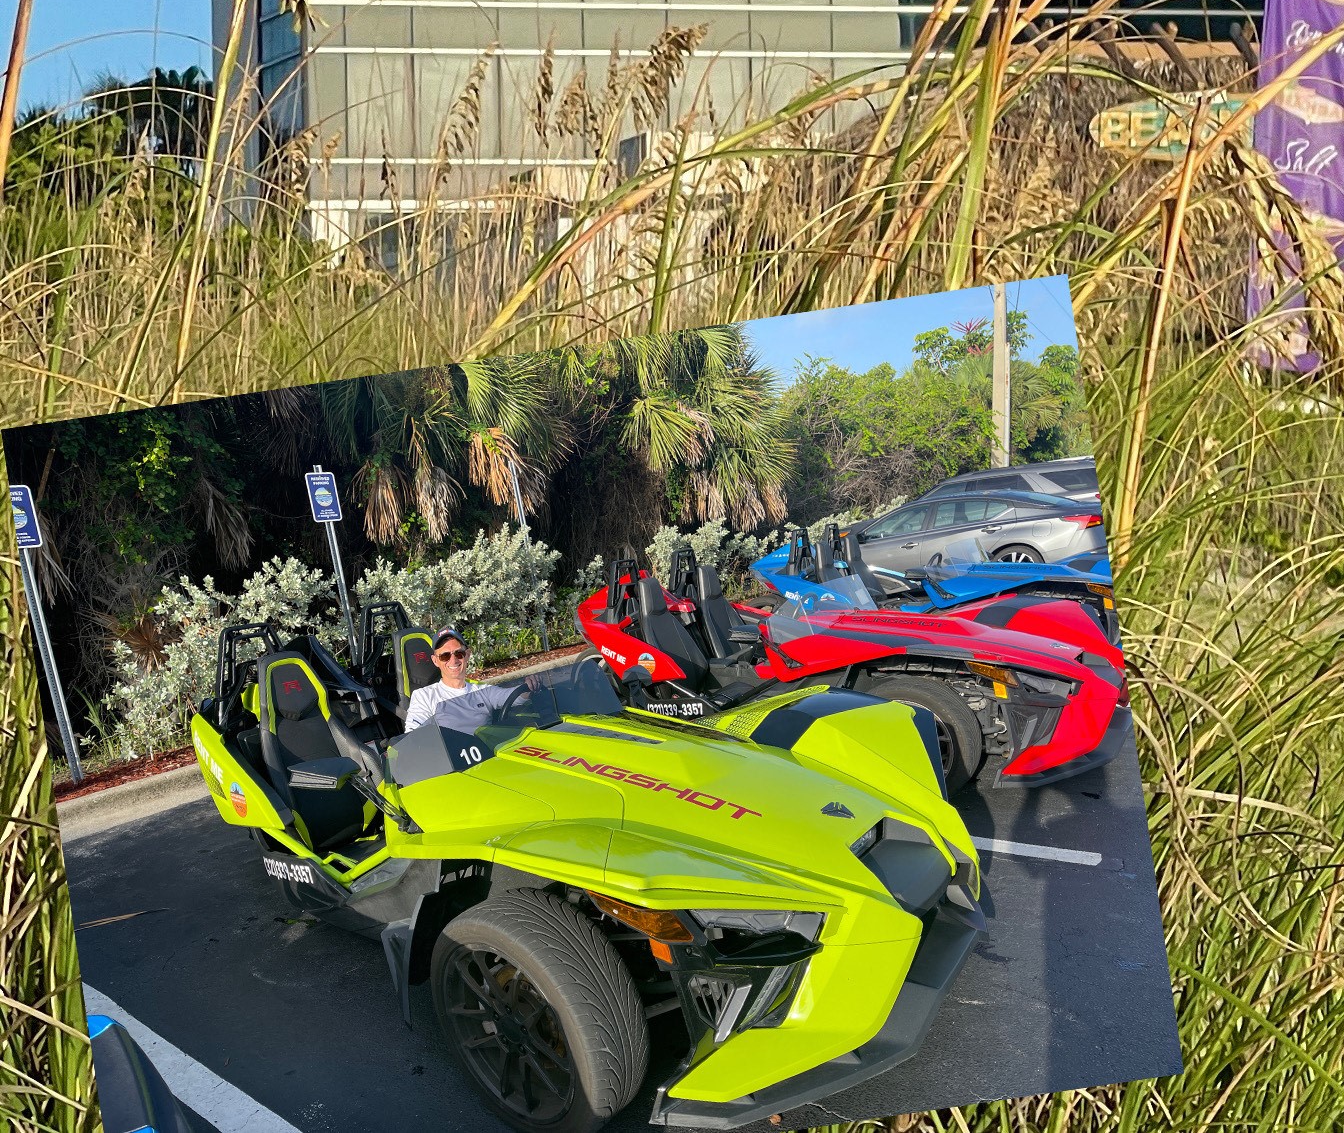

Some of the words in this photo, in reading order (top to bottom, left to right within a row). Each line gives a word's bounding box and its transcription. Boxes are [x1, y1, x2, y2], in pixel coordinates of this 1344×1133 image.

[851, 616, 947, 628] SLINGSHOT
[600, 645, 616, 661] RENT
[616, 653, 627, 666] ME
[194, 730, 210, 766] RENT
[210, 757, 224, 784] ME
[459, 746, 483, 765] 10
[513, 746, 763, 820] SLINGSHOT
